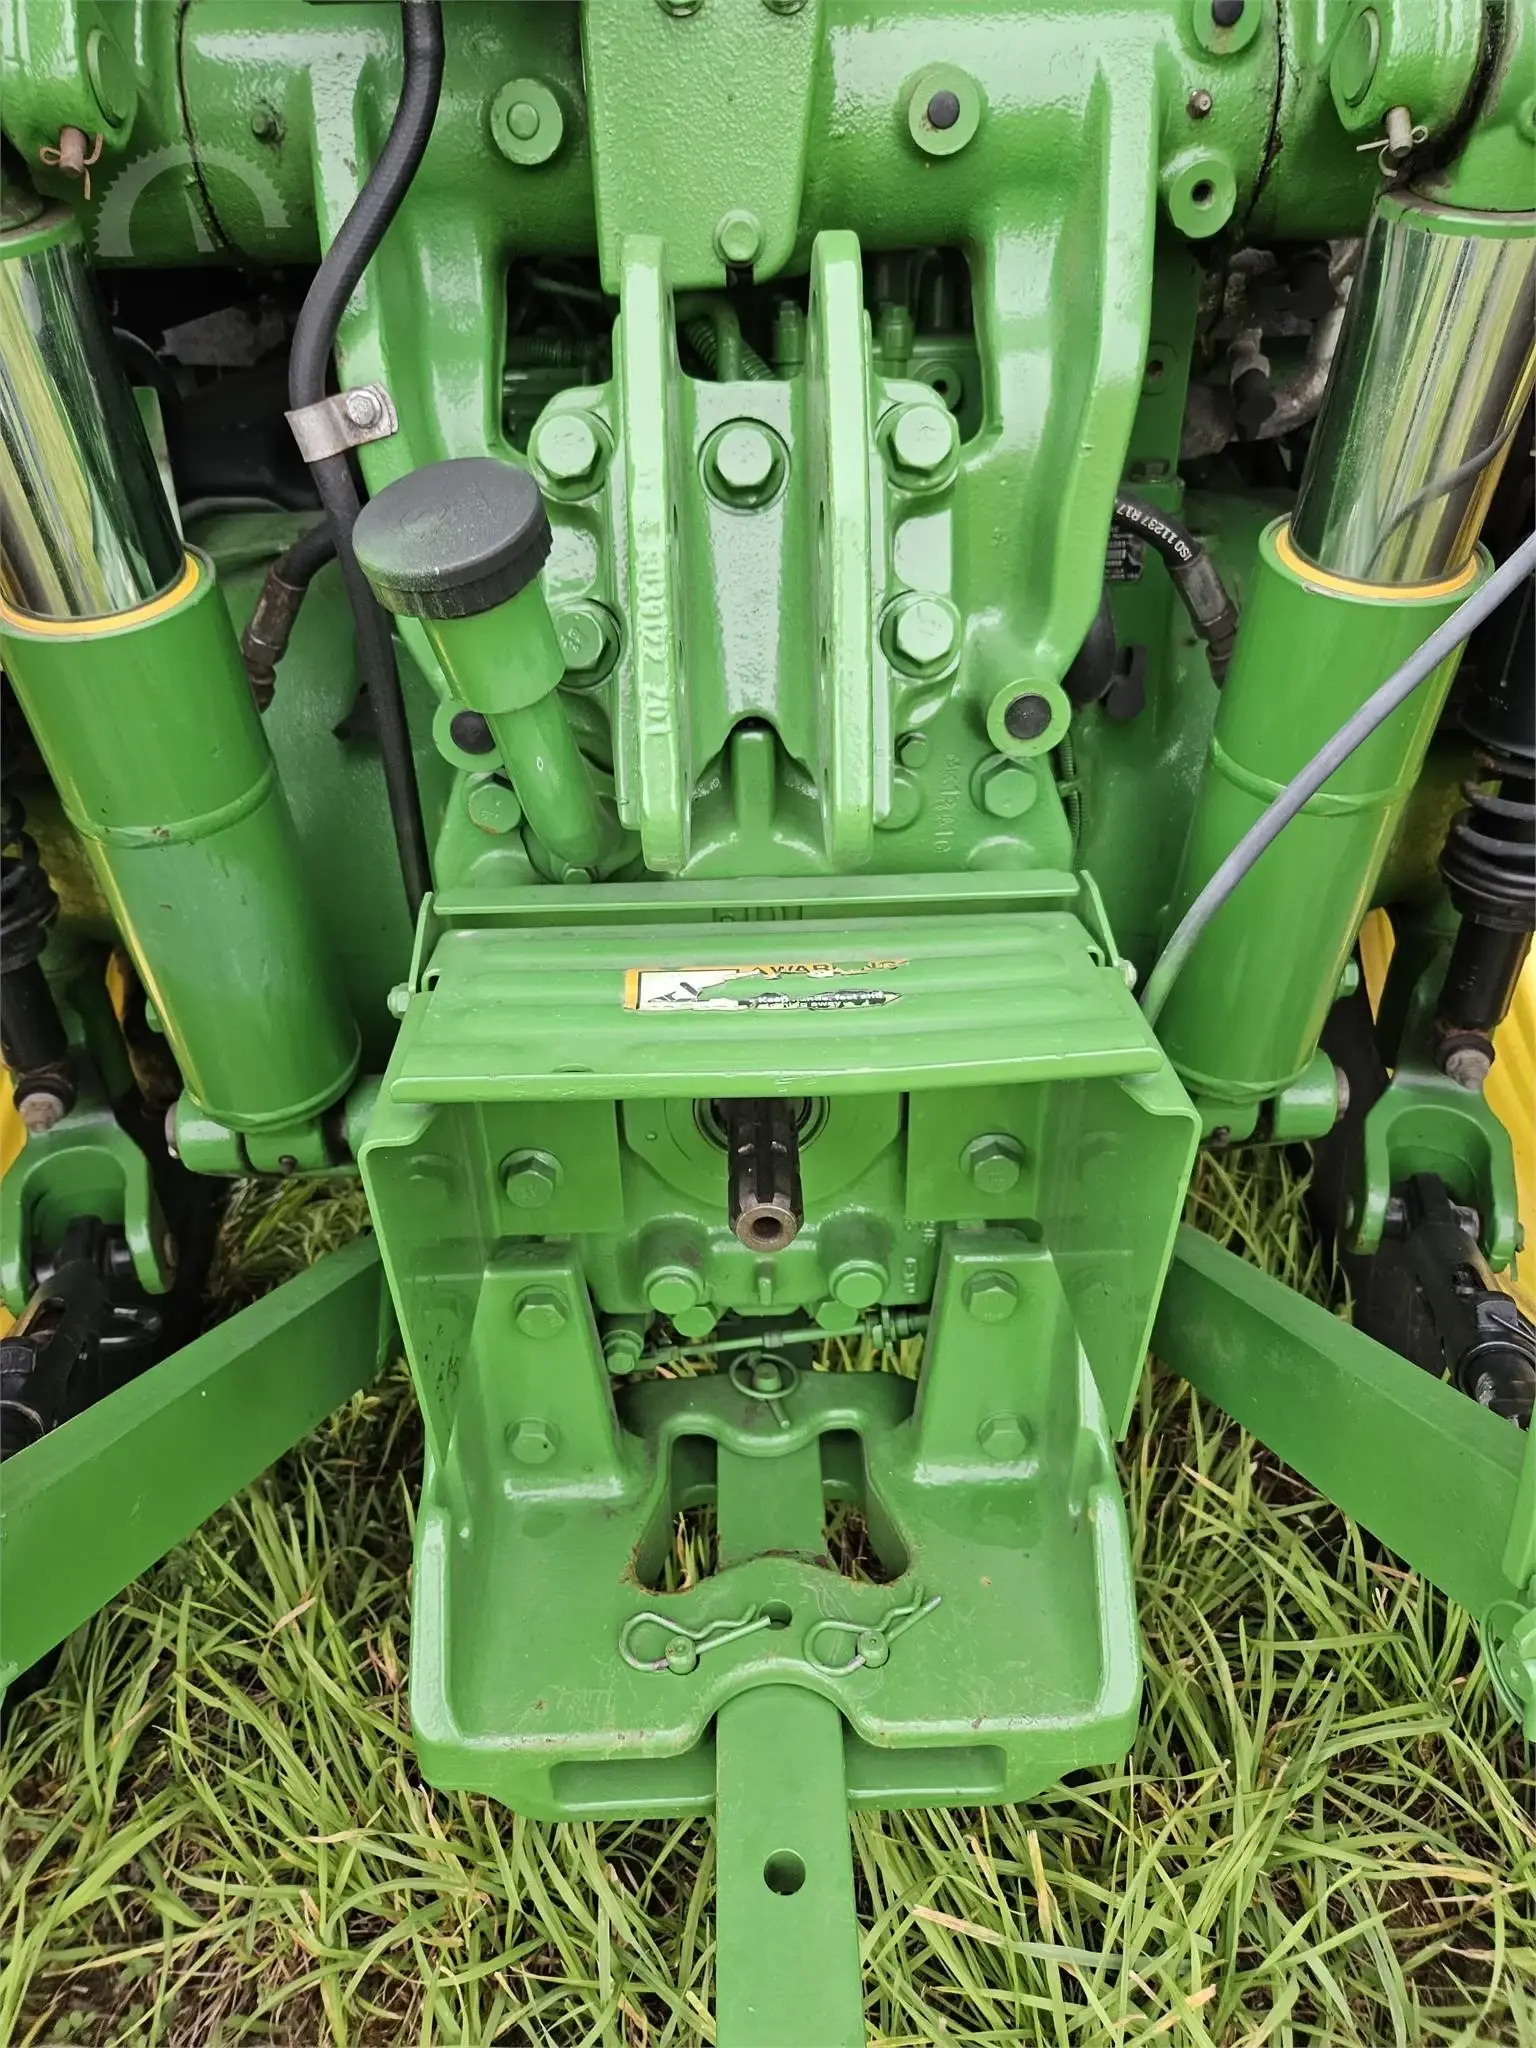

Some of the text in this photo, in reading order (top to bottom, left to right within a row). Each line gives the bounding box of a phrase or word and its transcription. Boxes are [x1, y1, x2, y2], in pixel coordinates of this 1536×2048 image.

[1116, 504, 1193, 561] ISO 11237 R17
